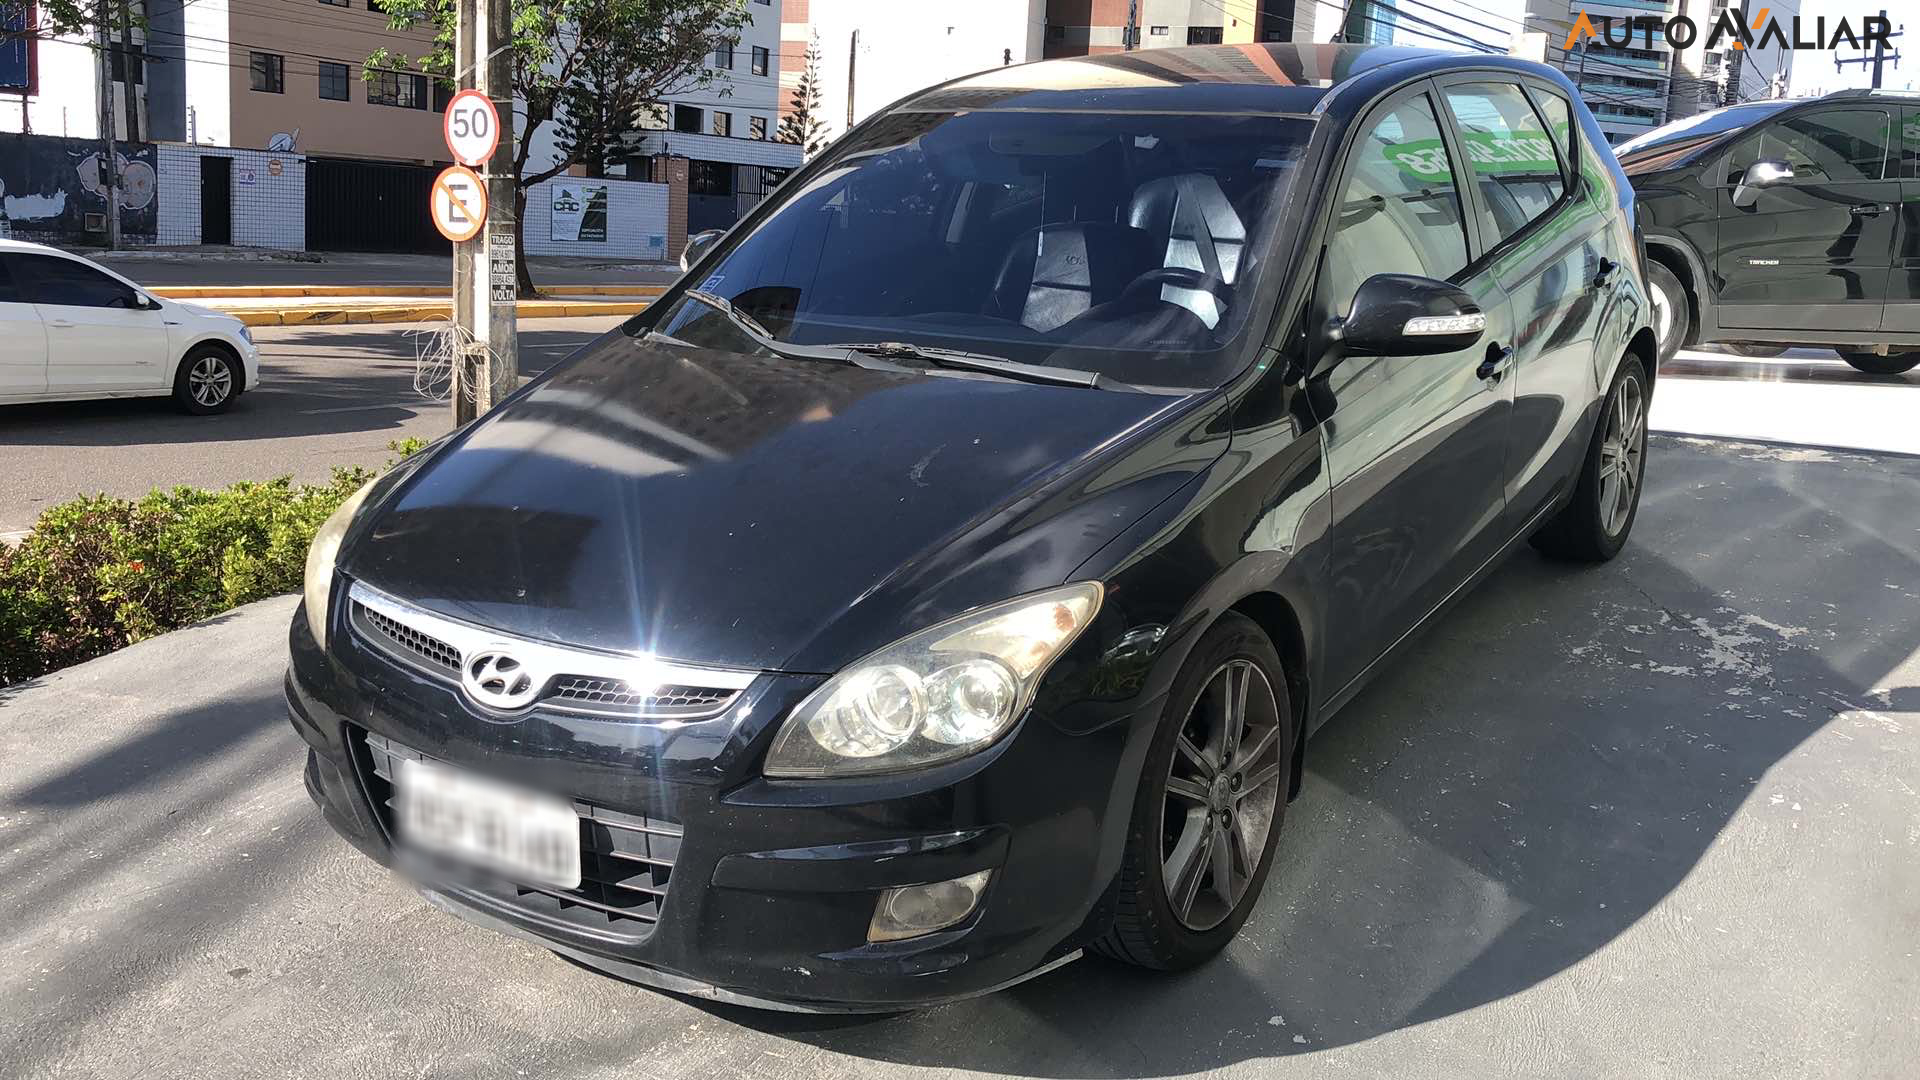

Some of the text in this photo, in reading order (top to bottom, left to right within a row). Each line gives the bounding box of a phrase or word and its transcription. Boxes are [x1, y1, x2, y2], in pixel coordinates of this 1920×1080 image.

[454, 108, 488, 138] 50
[448, 184, 469, 223] E
[491, 235, 513, 245] TRAGO
[492, 263, 514, 273] AMOR
[492, 290, 515, 301] VOLTA
